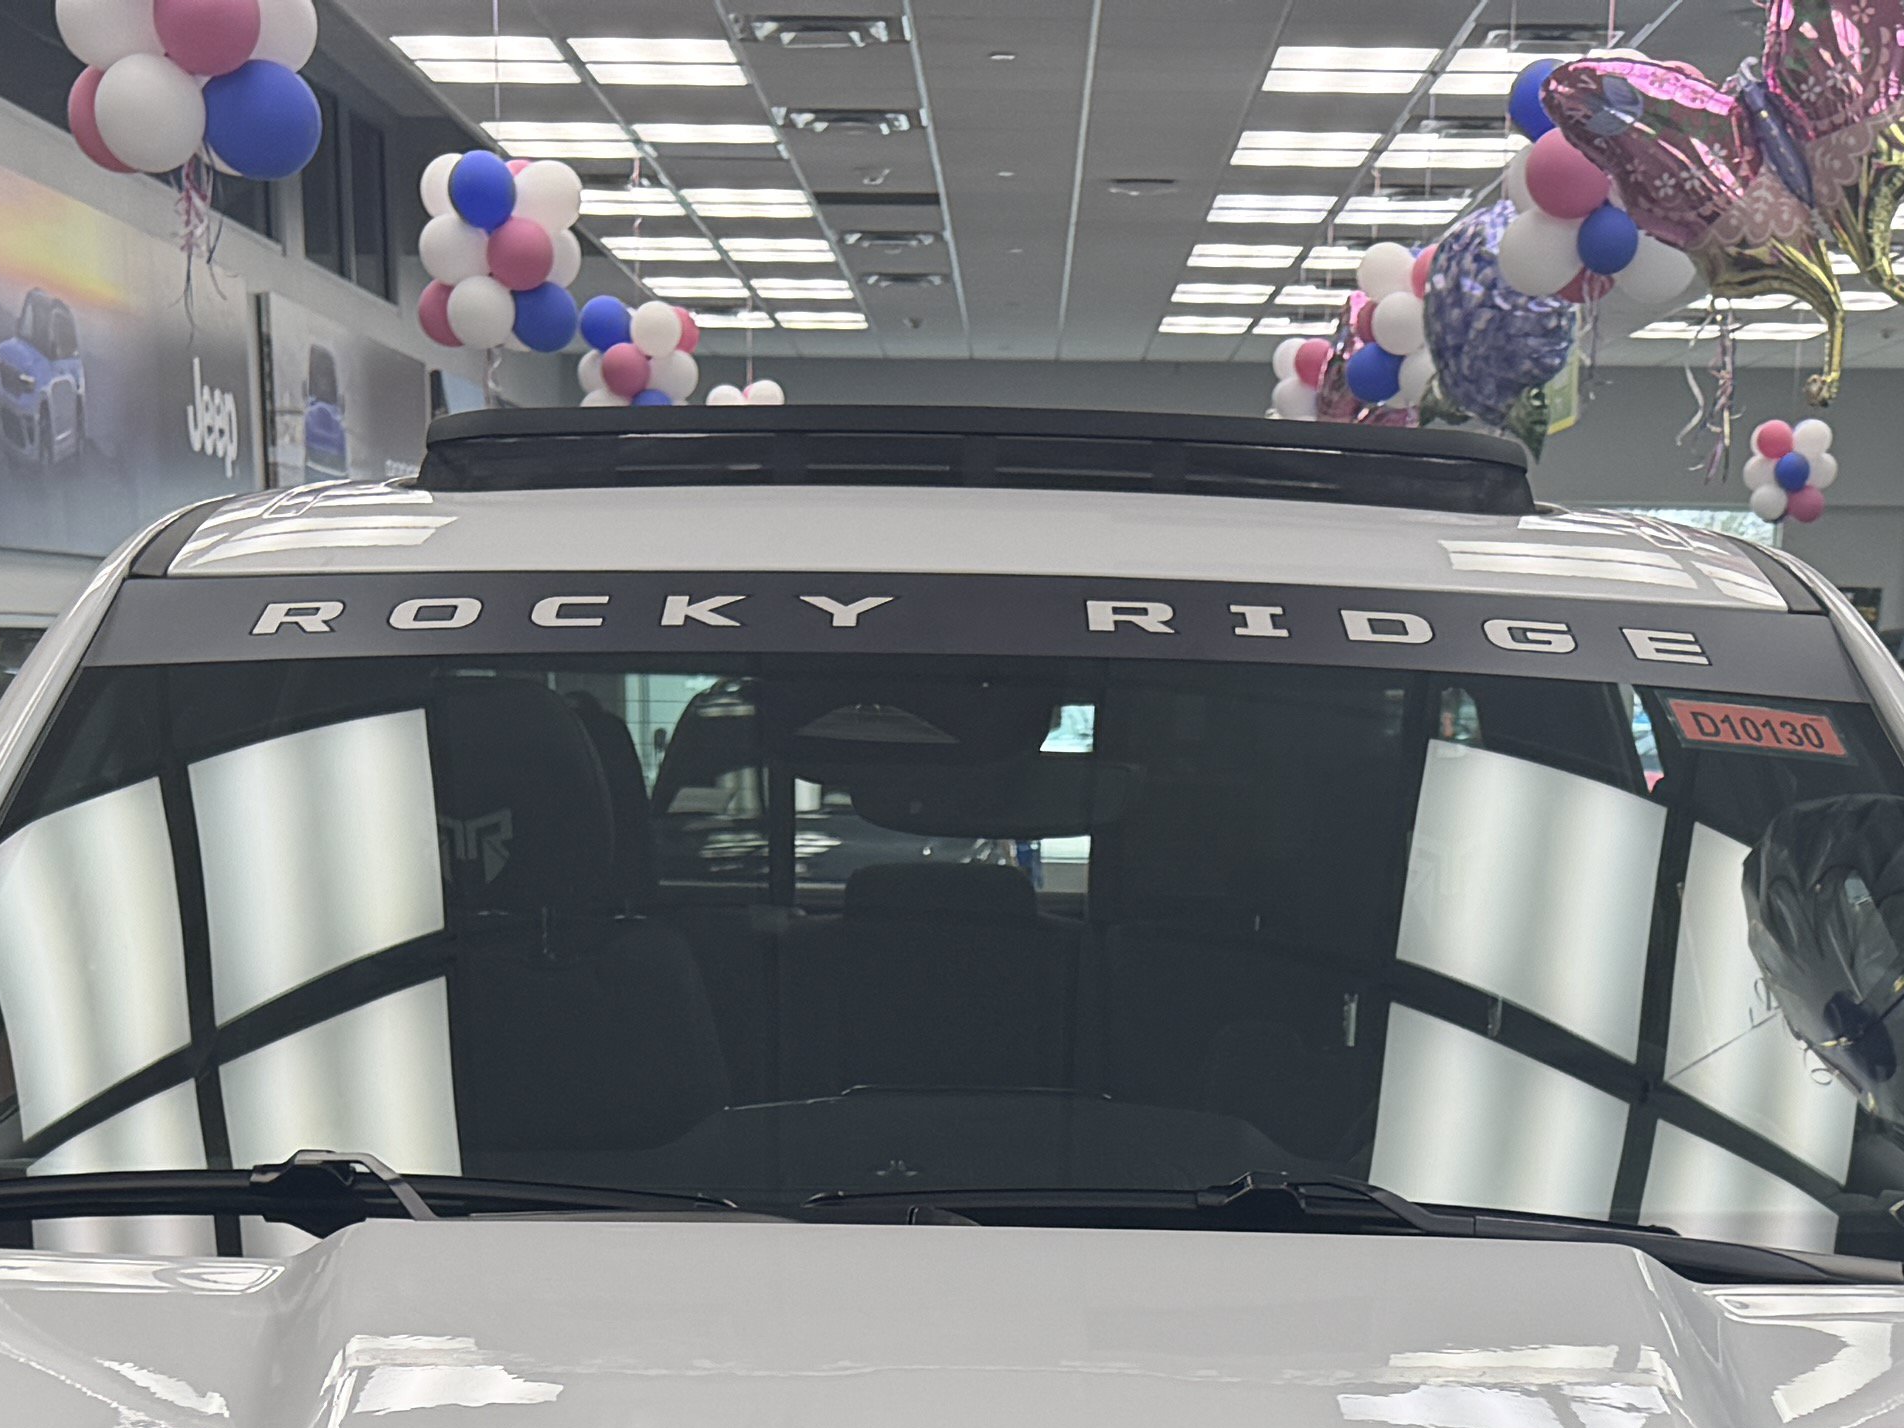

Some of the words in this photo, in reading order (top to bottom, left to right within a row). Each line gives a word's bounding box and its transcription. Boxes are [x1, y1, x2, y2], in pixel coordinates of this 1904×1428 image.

[187, 357, 238, 479] Jeep
[249, 594, 895, 636] ROCKY
[1085, 599, 1713, 667] RIDGE
[1690, 711, 1825, 749] D10130
